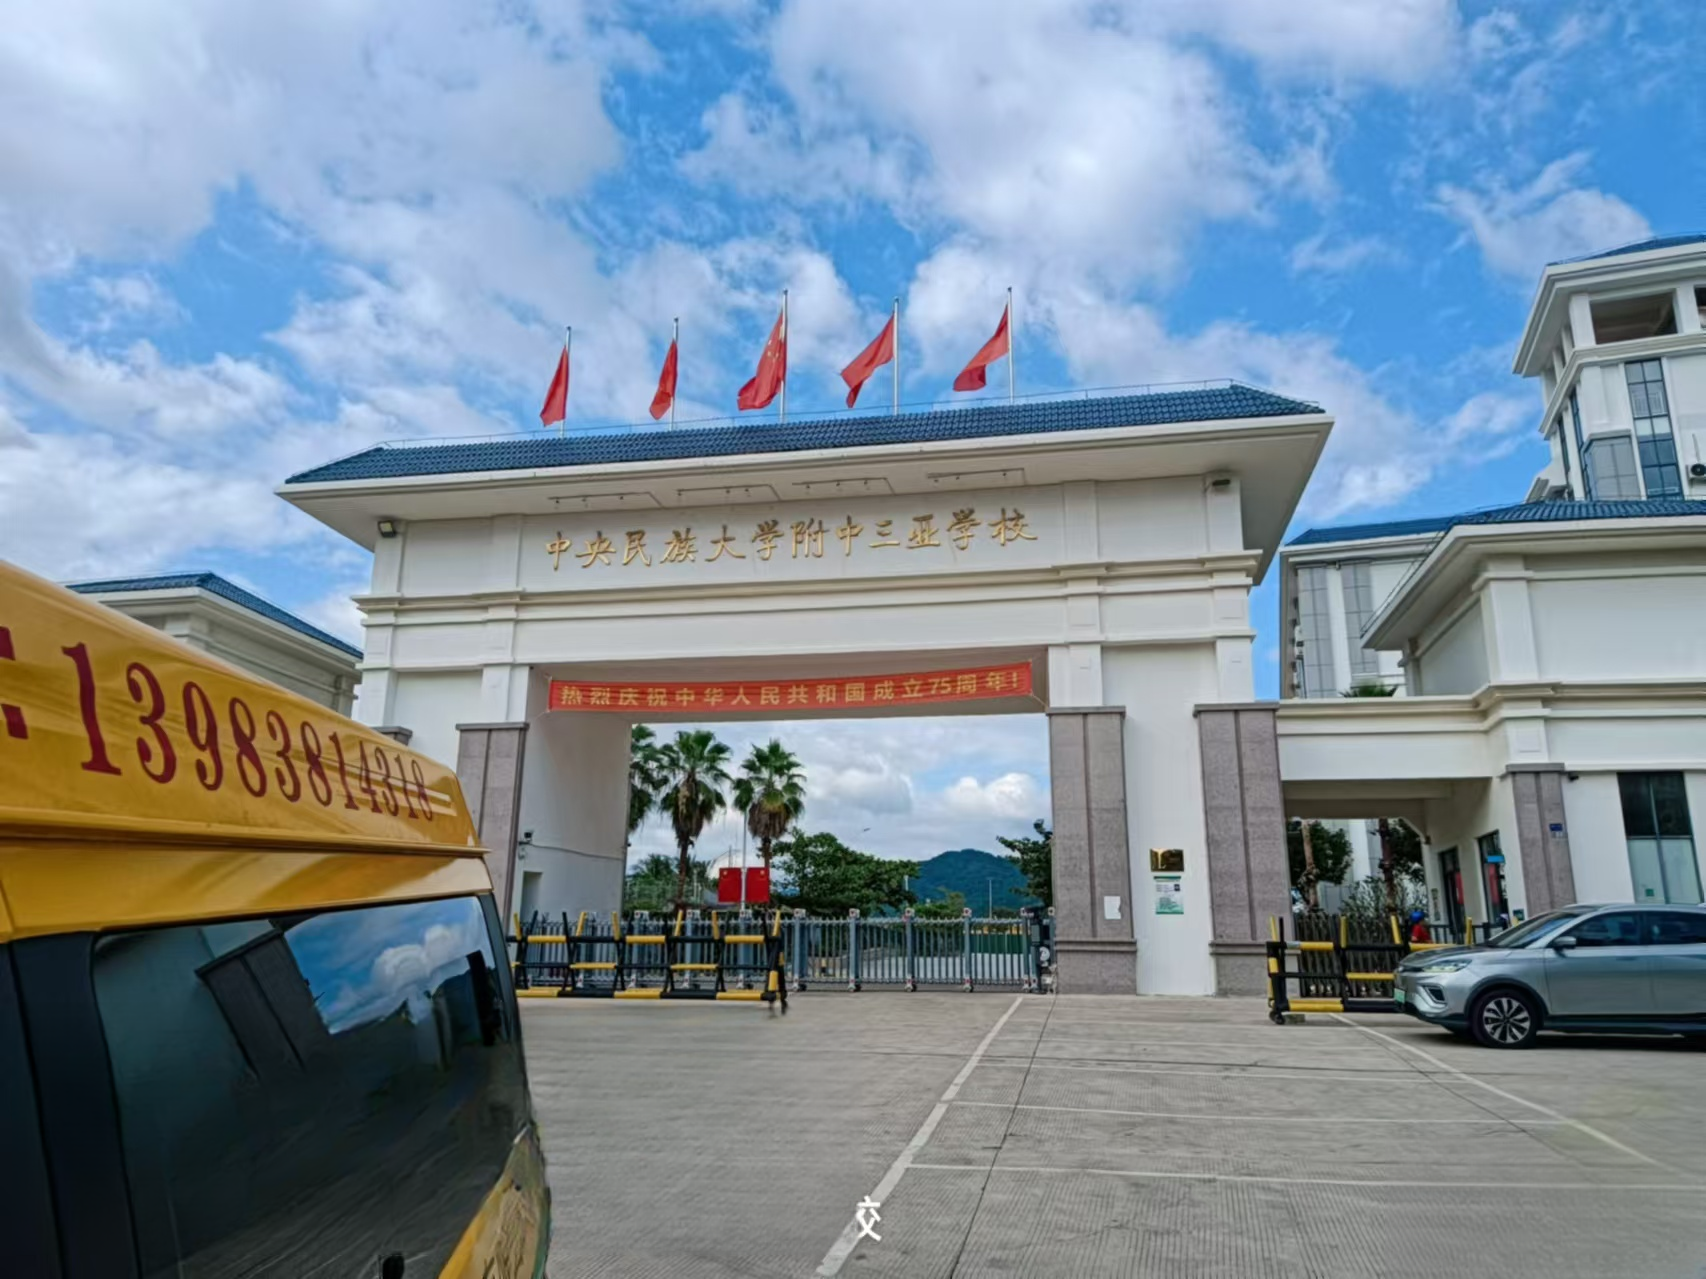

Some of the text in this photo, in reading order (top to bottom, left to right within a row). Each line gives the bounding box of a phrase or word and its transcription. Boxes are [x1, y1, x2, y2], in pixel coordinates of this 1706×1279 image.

[545, 507, 1038, 570] 中央民族大学附中三亚学校
